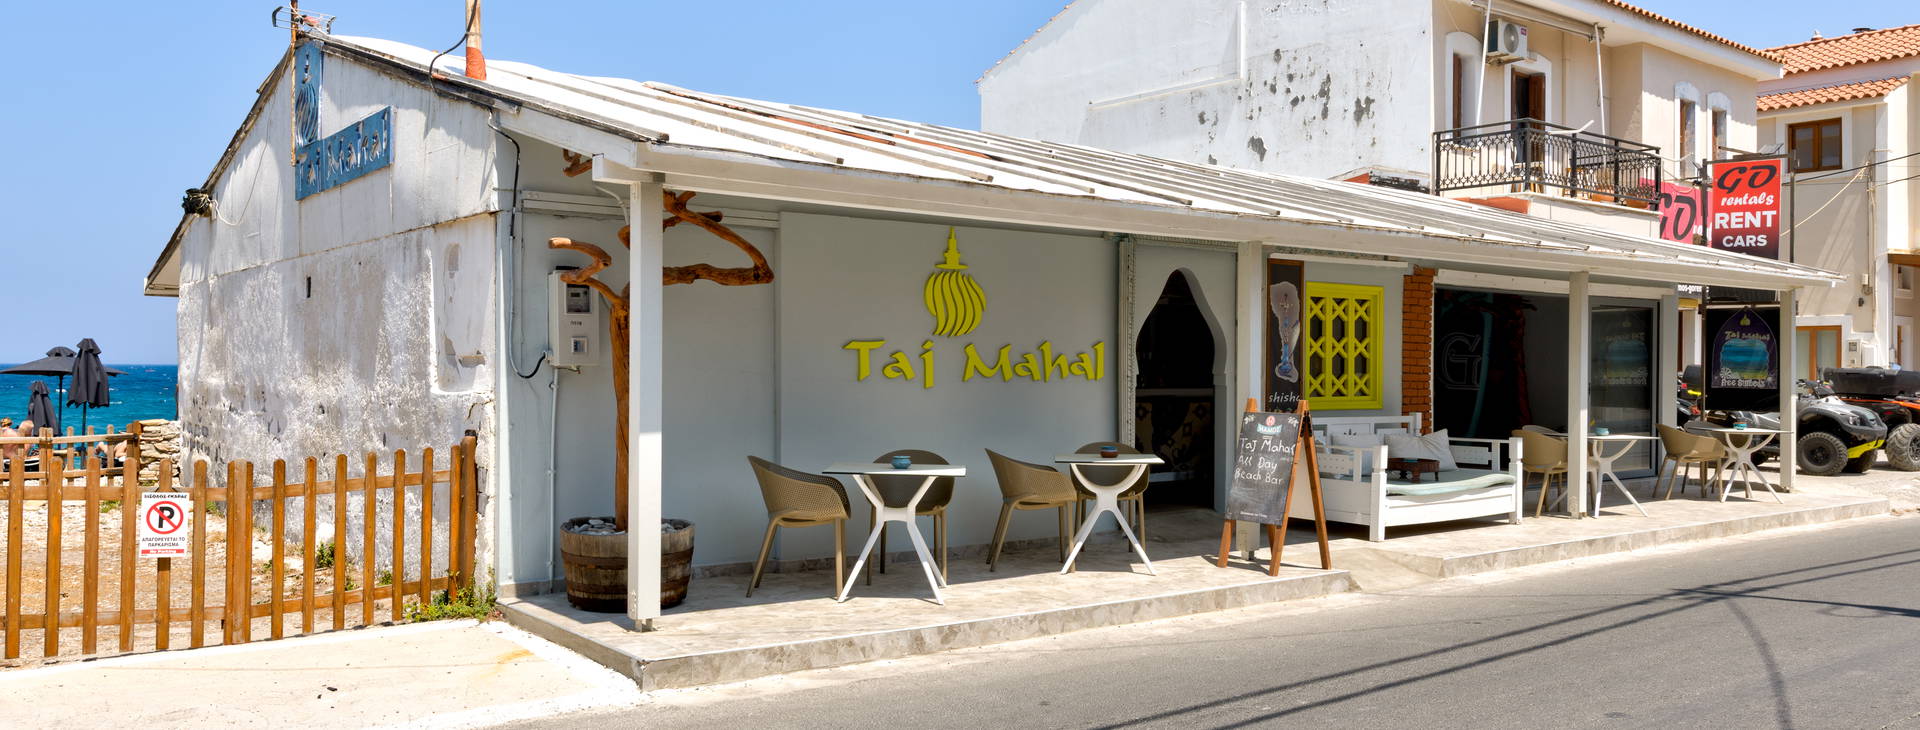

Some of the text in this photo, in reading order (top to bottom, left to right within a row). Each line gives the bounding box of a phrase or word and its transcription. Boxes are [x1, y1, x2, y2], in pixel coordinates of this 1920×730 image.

[326, 110, 389, 181] Mahal
[1717, 164, 1777, 194] GO
[1721, 191, 1774, 207] rentals
[1714, 210, 1777, 230] RENT
[1722, 234, 1767, 248] CARS
[842, 340, 1105, 389] Taj Mahal
[1261, 440, 1296, 457] Mahal
[1238, 455, 1277, 474] All Day
[1234, 467, 1282, 485] Beach Bar
